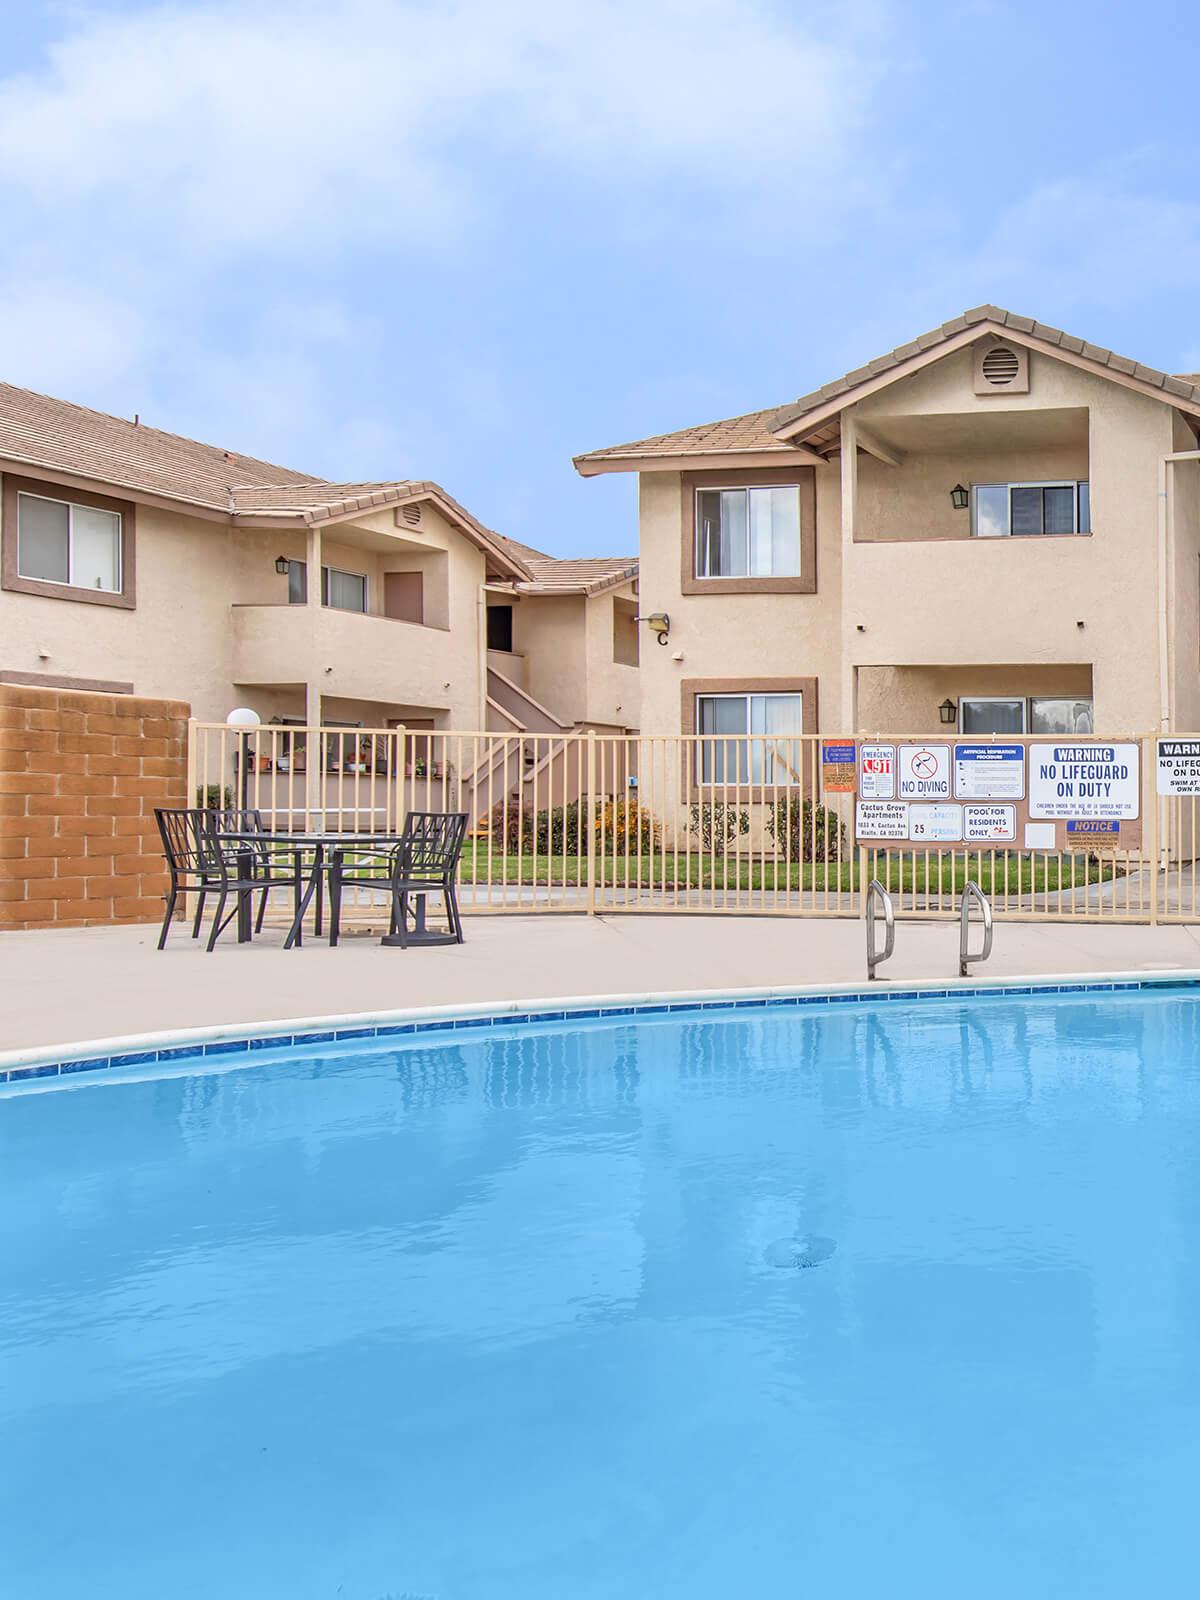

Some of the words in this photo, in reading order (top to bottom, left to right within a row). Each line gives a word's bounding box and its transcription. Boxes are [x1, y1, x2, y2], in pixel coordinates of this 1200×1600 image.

[657, 631, 669, 646] C
[863, 751, 893, 759] EMERGENCY
[1057, 749, 1111, 761] WARNING
[872, 759, 892, 773] 911
[1159, 759, 1173, 768] NO
[1040, 764, 1057, 780] NO
[1062, 764, 1128, 780] LIFEGUARD
[1173, 769, 1187, 777] ON
[902, 780, 916, 793] NO
[918, 780, 948, 793] DIVING
[1057, 782, 1073, 798] ON
[1079, 782, 1111, 798] DUTY
[860, 803, 884, 811] Cactus
[863, 811, 903, 819] Apartments
[968, 818, 1007, 826] RESIDENTS
[1074, 821, 1114, 831] NOTICE
[914, 824, 925, 834] 25
[969, 829, 988, 837] ONLY
